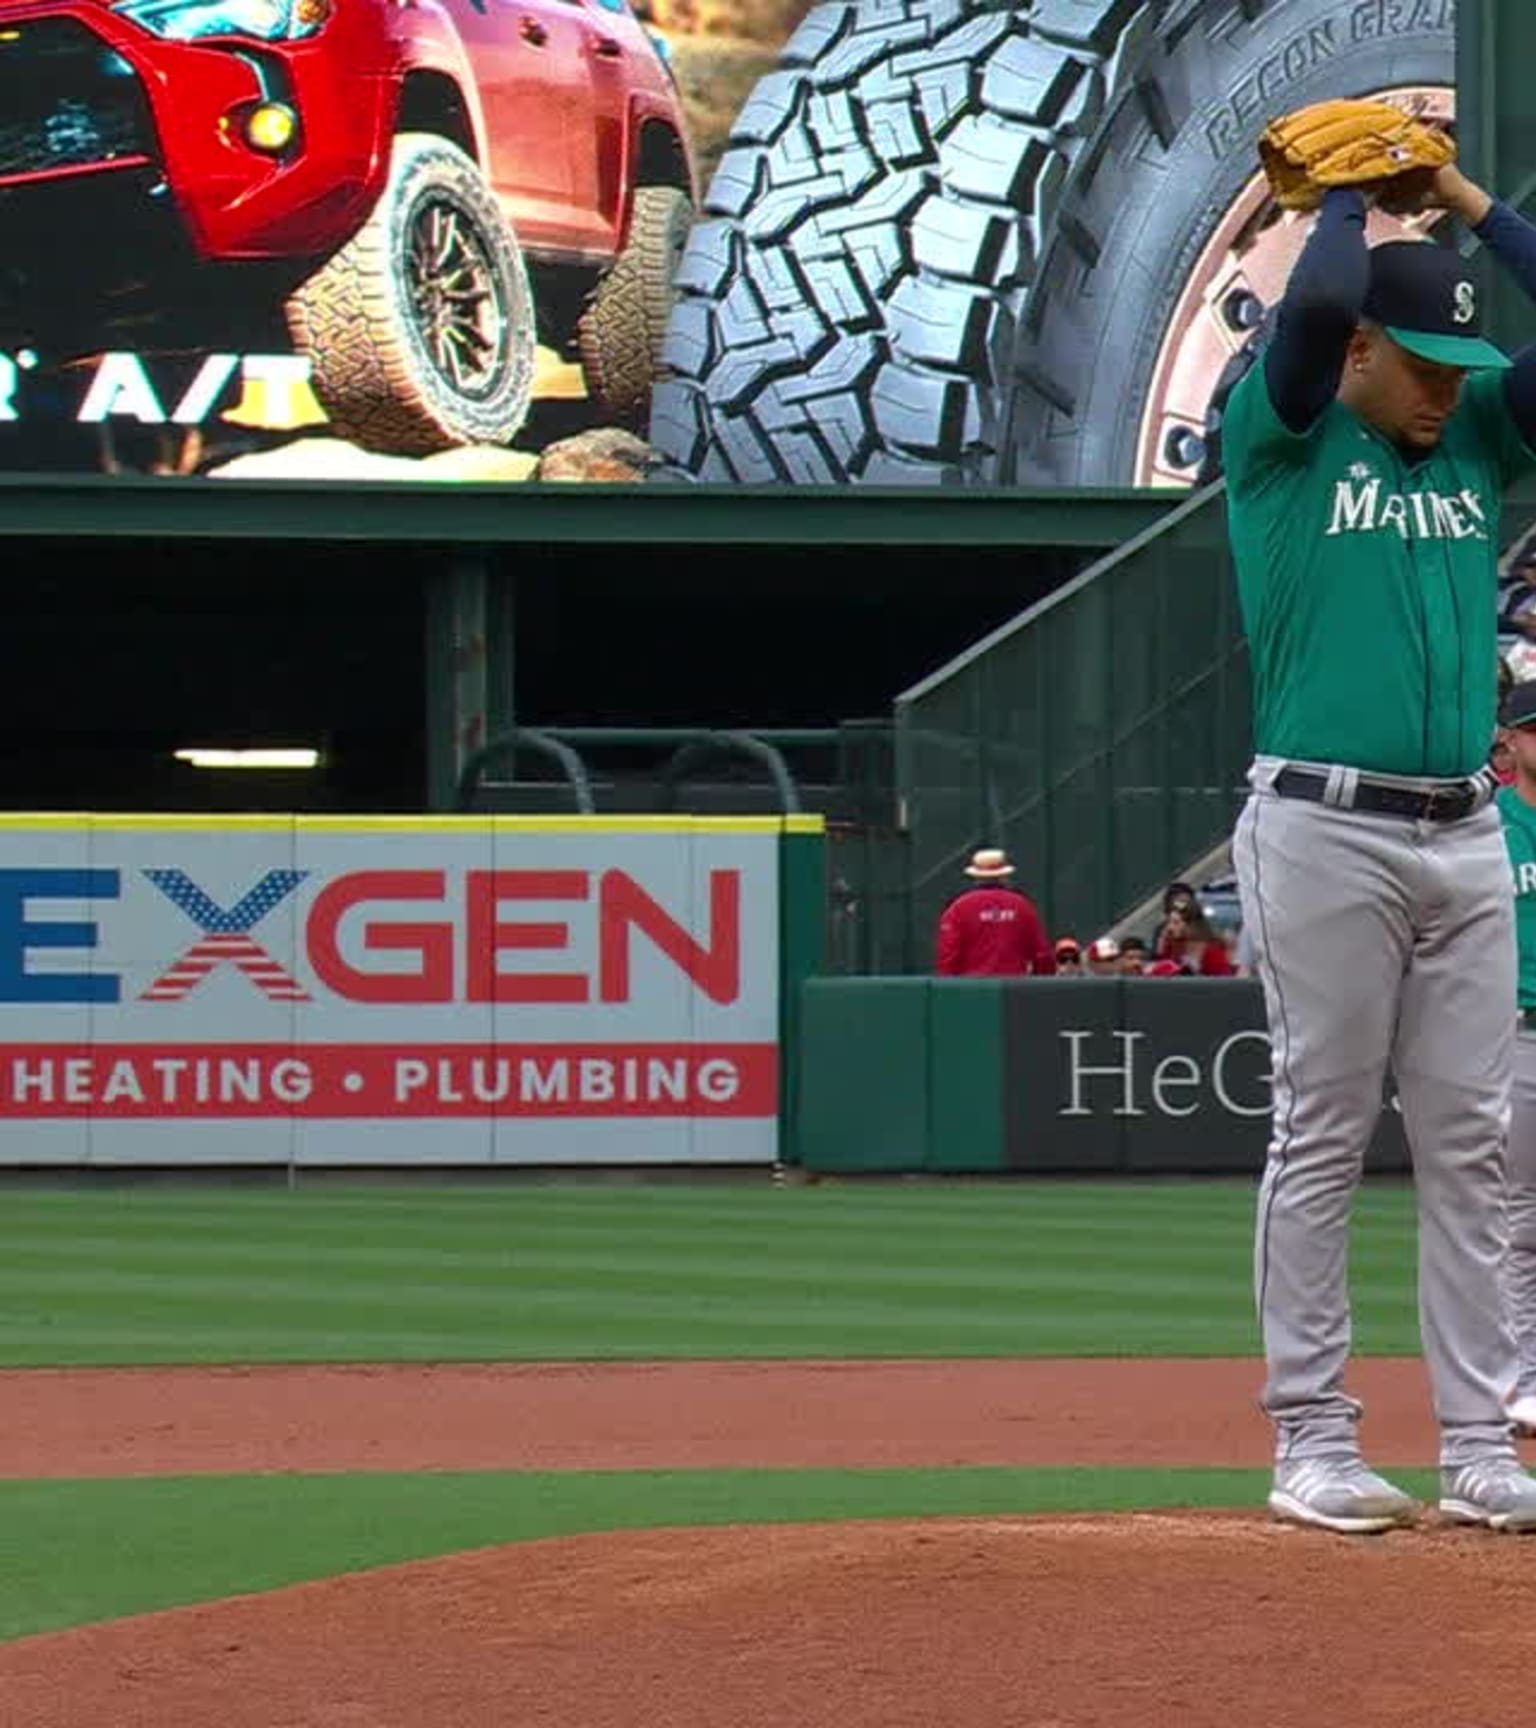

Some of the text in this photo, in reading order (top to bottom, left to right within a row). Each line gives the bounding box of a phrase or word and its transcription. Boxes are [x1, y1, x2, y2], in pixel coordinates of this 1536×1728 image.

[1203, 18, 1340, 161] RECON
[1453, 281, 1475, 324] S
[76, 351, 312, 423] A/T
[13, 1058, 741, 1103] HEATING PLUMBING
